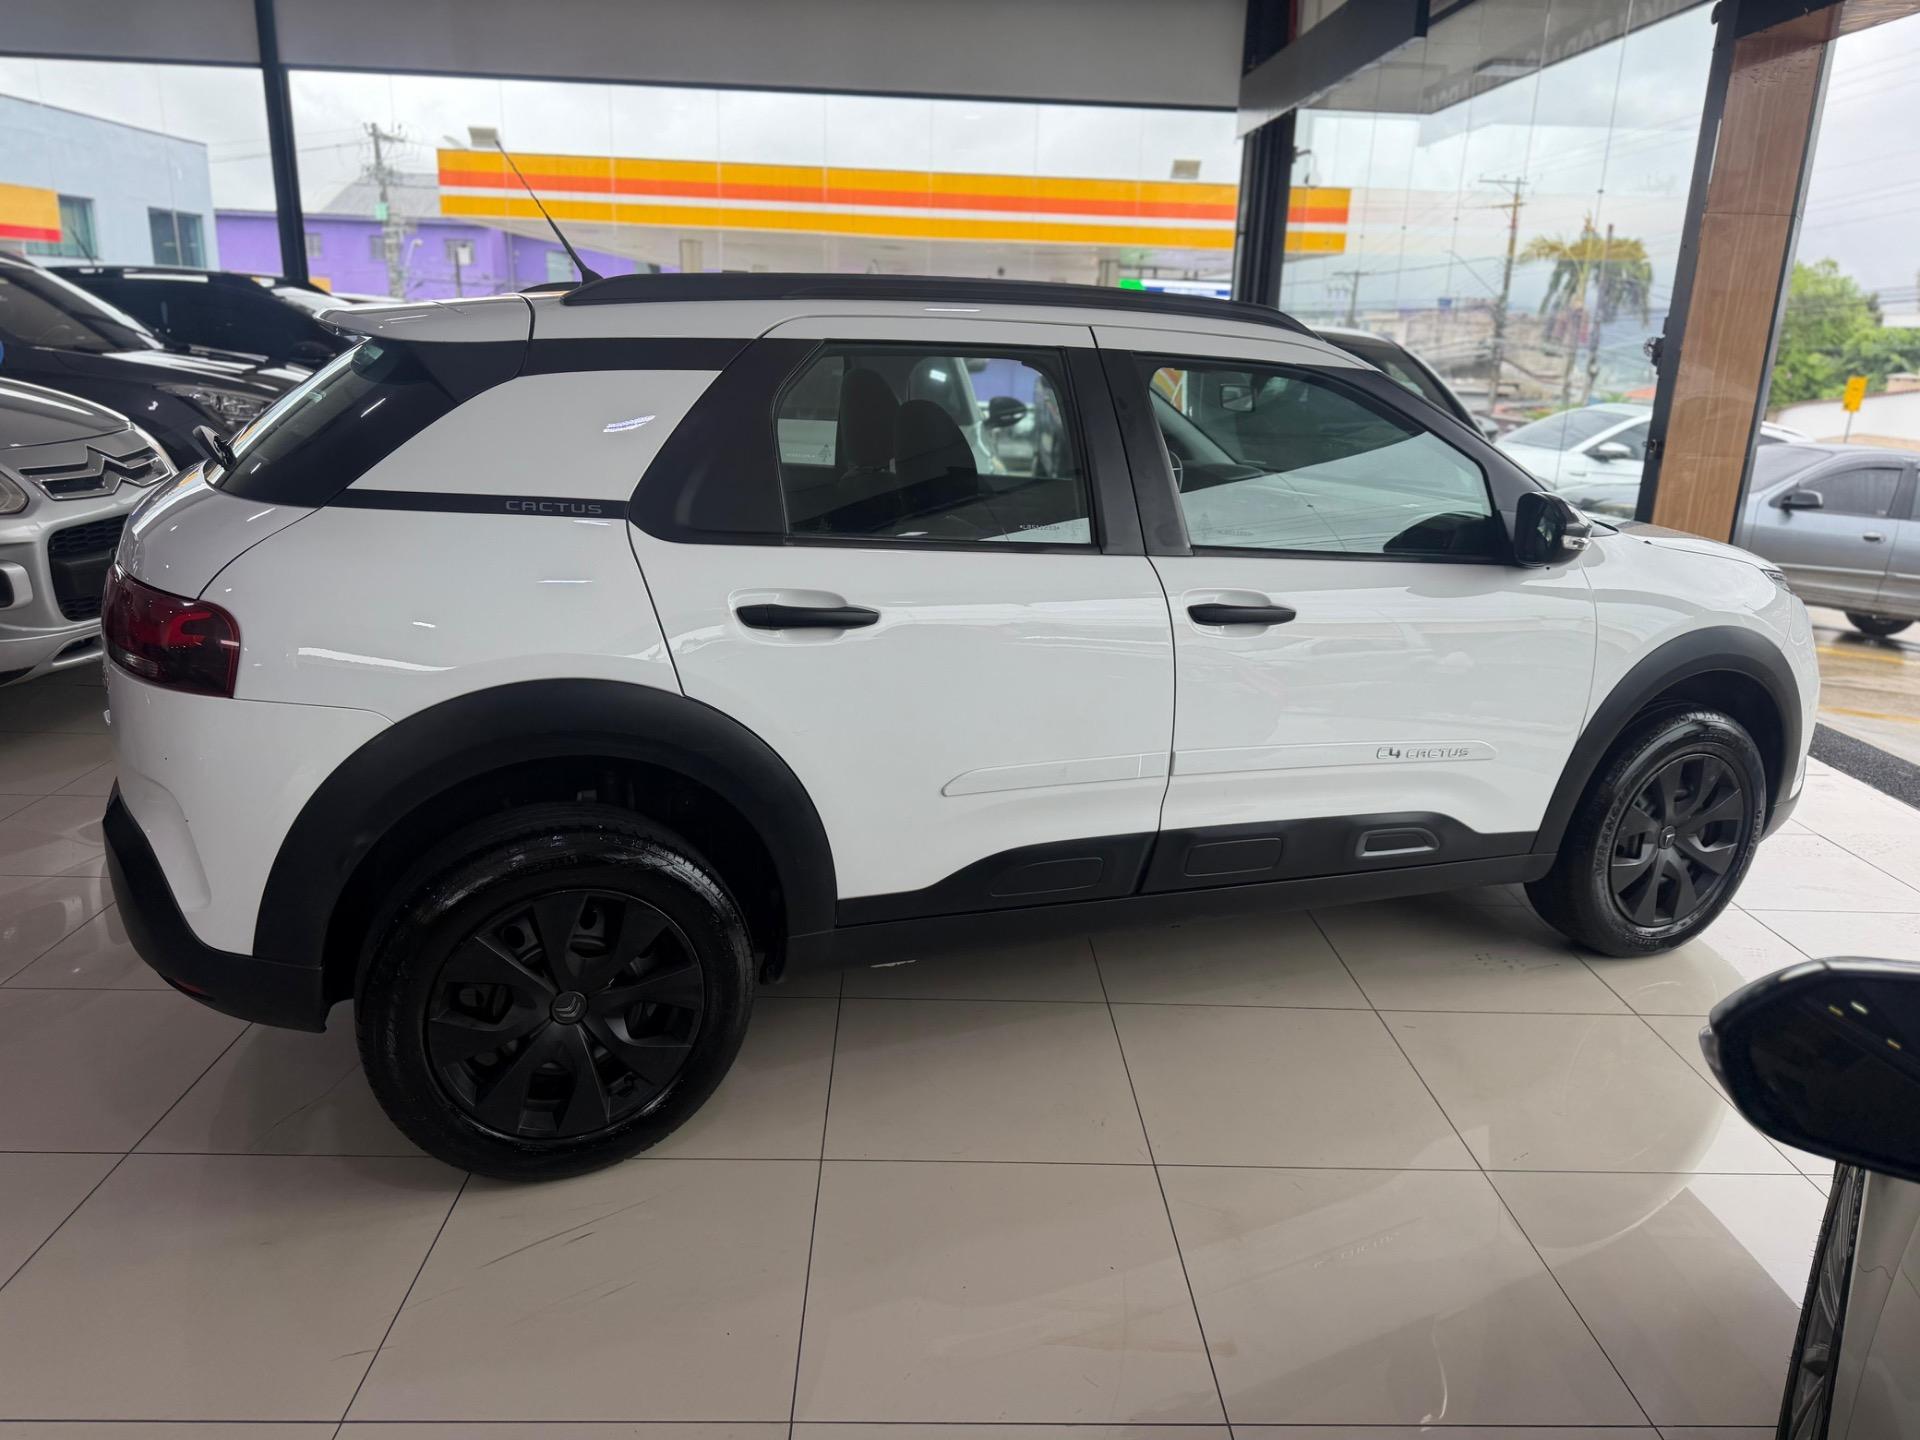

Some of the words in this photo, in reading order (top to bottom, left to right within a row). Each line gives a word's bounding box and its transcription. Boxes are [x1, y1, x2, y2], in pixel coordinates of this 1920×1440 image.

[505, 500, 603, 514] CACTUS
[1376, 746, 1401, 760] C4
[1405, 747, 1470, 759] CACTUS
